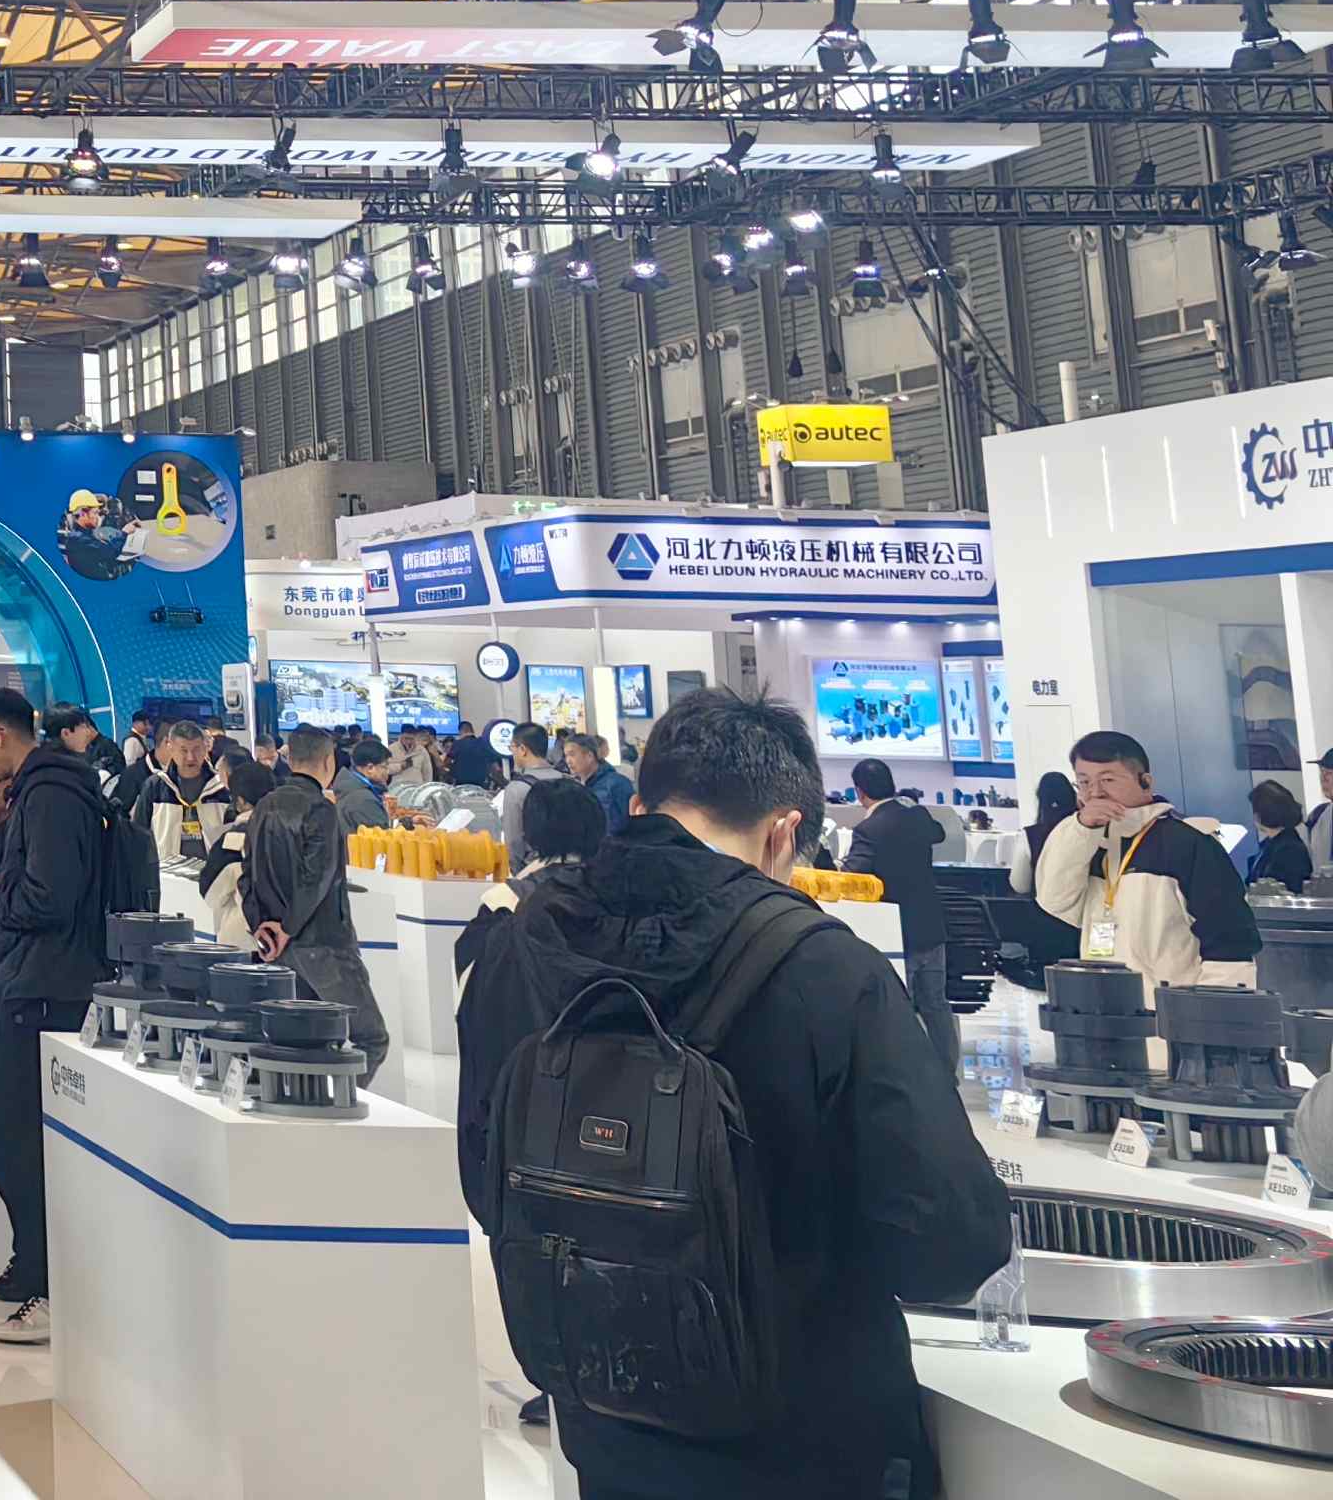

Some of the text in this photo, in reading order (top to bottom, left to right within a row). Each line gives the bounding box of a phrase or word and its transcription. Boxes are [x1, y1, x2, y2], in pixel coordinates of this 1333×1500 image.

[199, 37, 430, 62] VALUE
[191, 148, 378, 161] WOLD
[815, 426, 882, 442] autec
[666, 537, 984, 566] 河北力顿液压机械有限公司
[668, 565, 988, 582] HEBEI LIDUN HYDRAULIC MACHINERY CO.,LTD.
[284, 605, 355, 620] Dongguan
